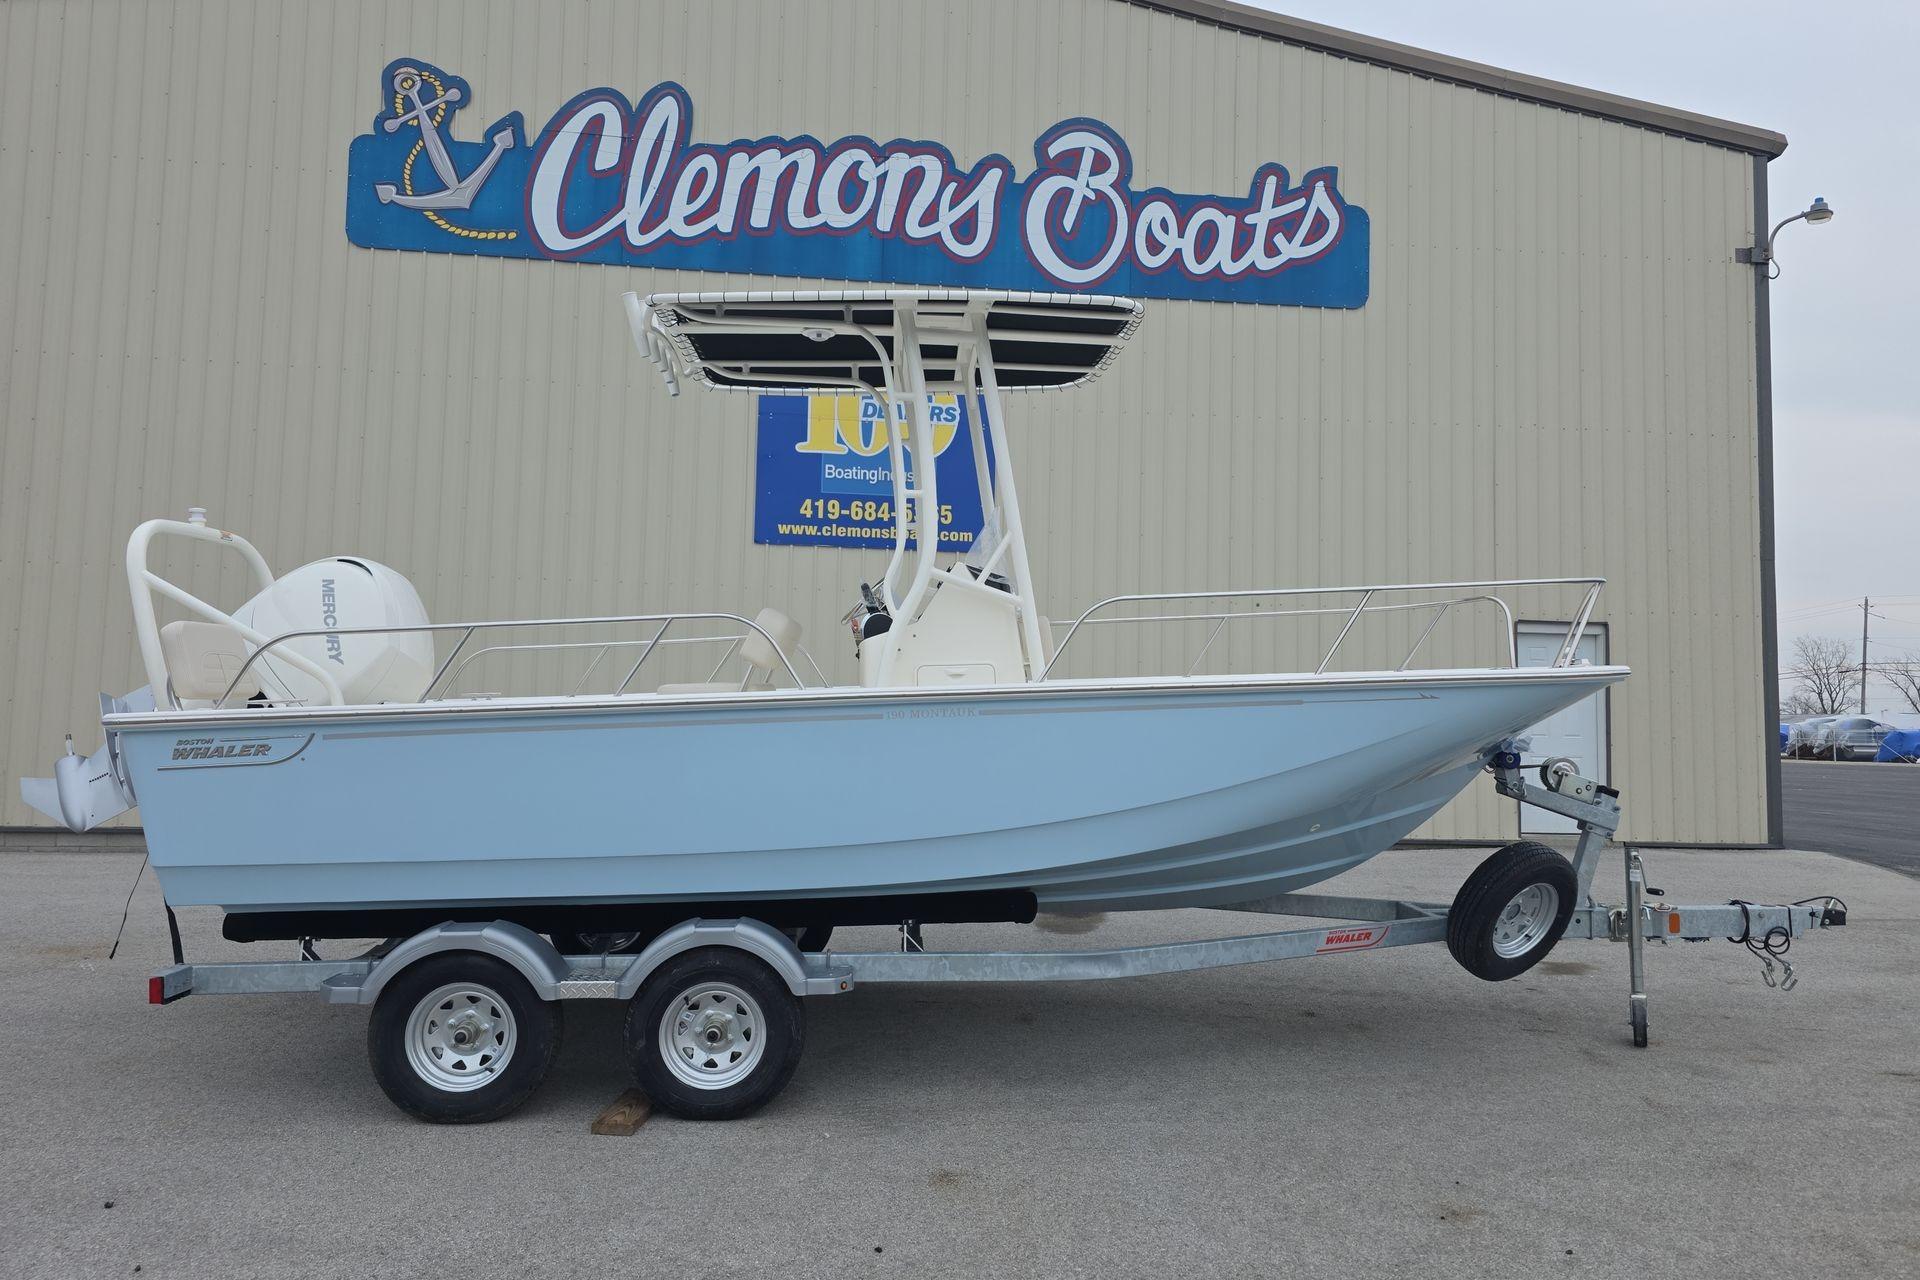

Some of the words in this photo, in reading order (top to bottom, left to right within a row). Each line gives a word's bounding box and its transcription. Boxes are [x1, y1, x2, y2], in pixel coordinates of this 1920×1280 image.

[531, 94, 1003, 258] Clemons
[1025, 131, 1341, 284] Boats
[862, 401, 958, 423] DERS
[800, 498, 953, 525] 419-684-55
[778, 523, 973, 542] www.clemonsba.com
[322, 579, 344, 665] MERCURY
[911, 707, 975, 719] MONTAUK
[176, 738, 215, 746] BOSTON
[172, 744, 272, 760] WHALER
[1325, 931, 1372, 945] WHALER
